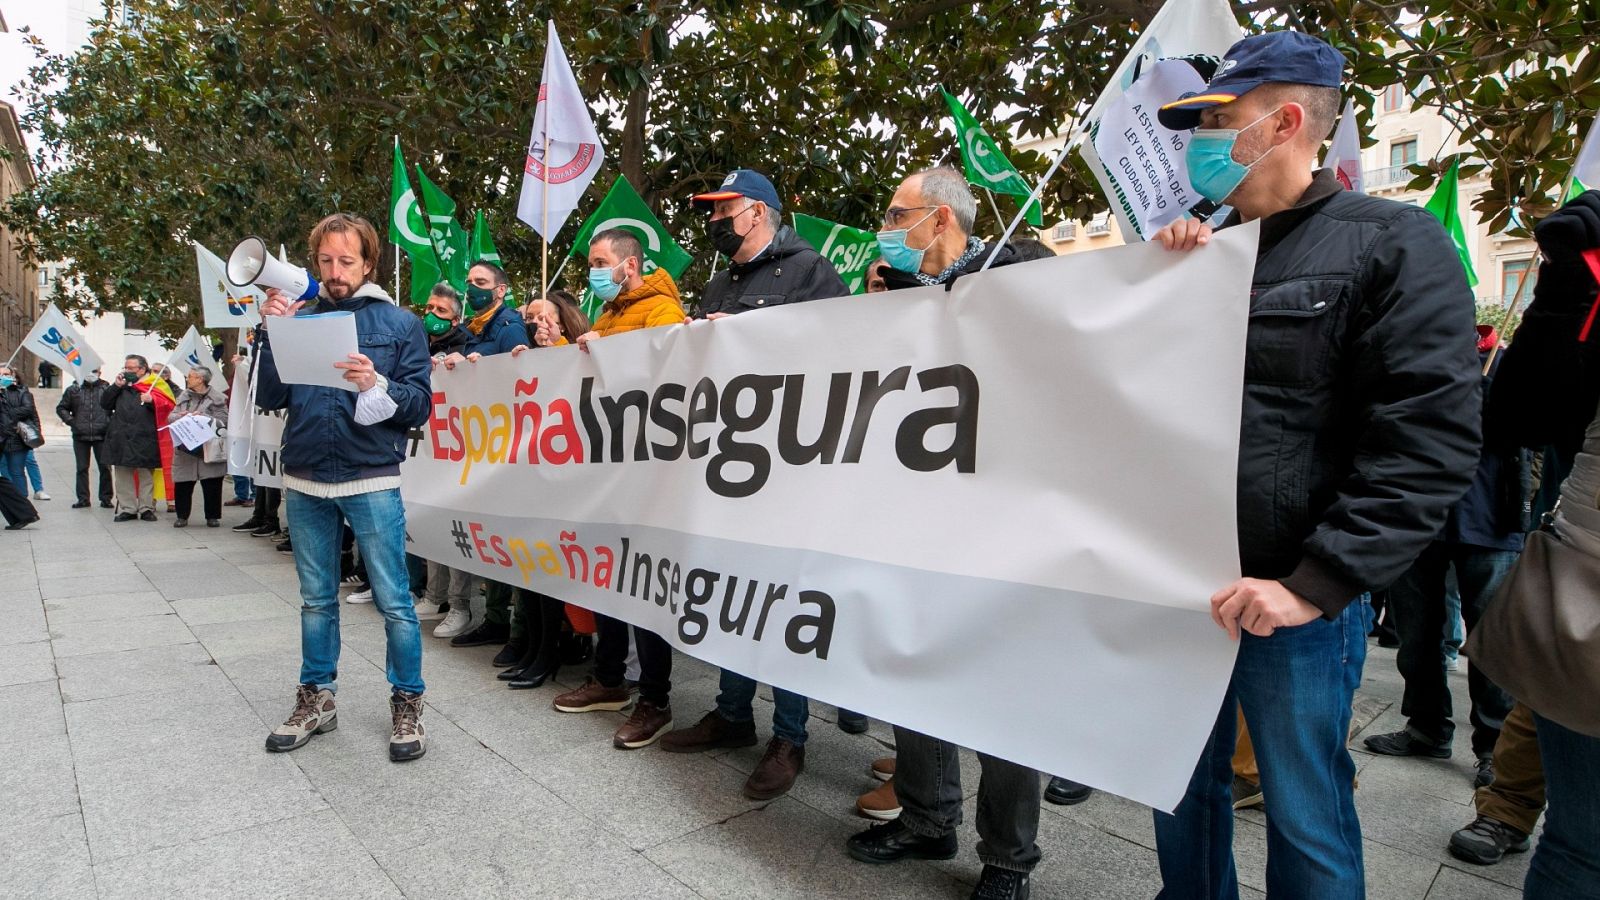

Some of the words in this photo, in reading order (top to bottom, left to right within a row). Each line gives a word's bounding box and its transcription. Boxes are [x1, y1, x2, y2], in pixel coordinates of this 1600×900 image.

[1123, 127, 1139, 147] LEY
[1135, 144, 1147, 162] DE
[1132, 104, 1142, 115] A
[1138, 113, 1153, 139] ESTA
[1150, 136, 1175, 182] REFORMA
[1169, 180, 1184, 197] DE
[1177, 193, 1189, 208] LA
[1170, 133, 1184, 151] NO
[1119, 156, 1151, 211] CIUDADANA
[829, 241, 879, 275] CSIF
[451, 519, 836, 661] #EspañaInsegura
